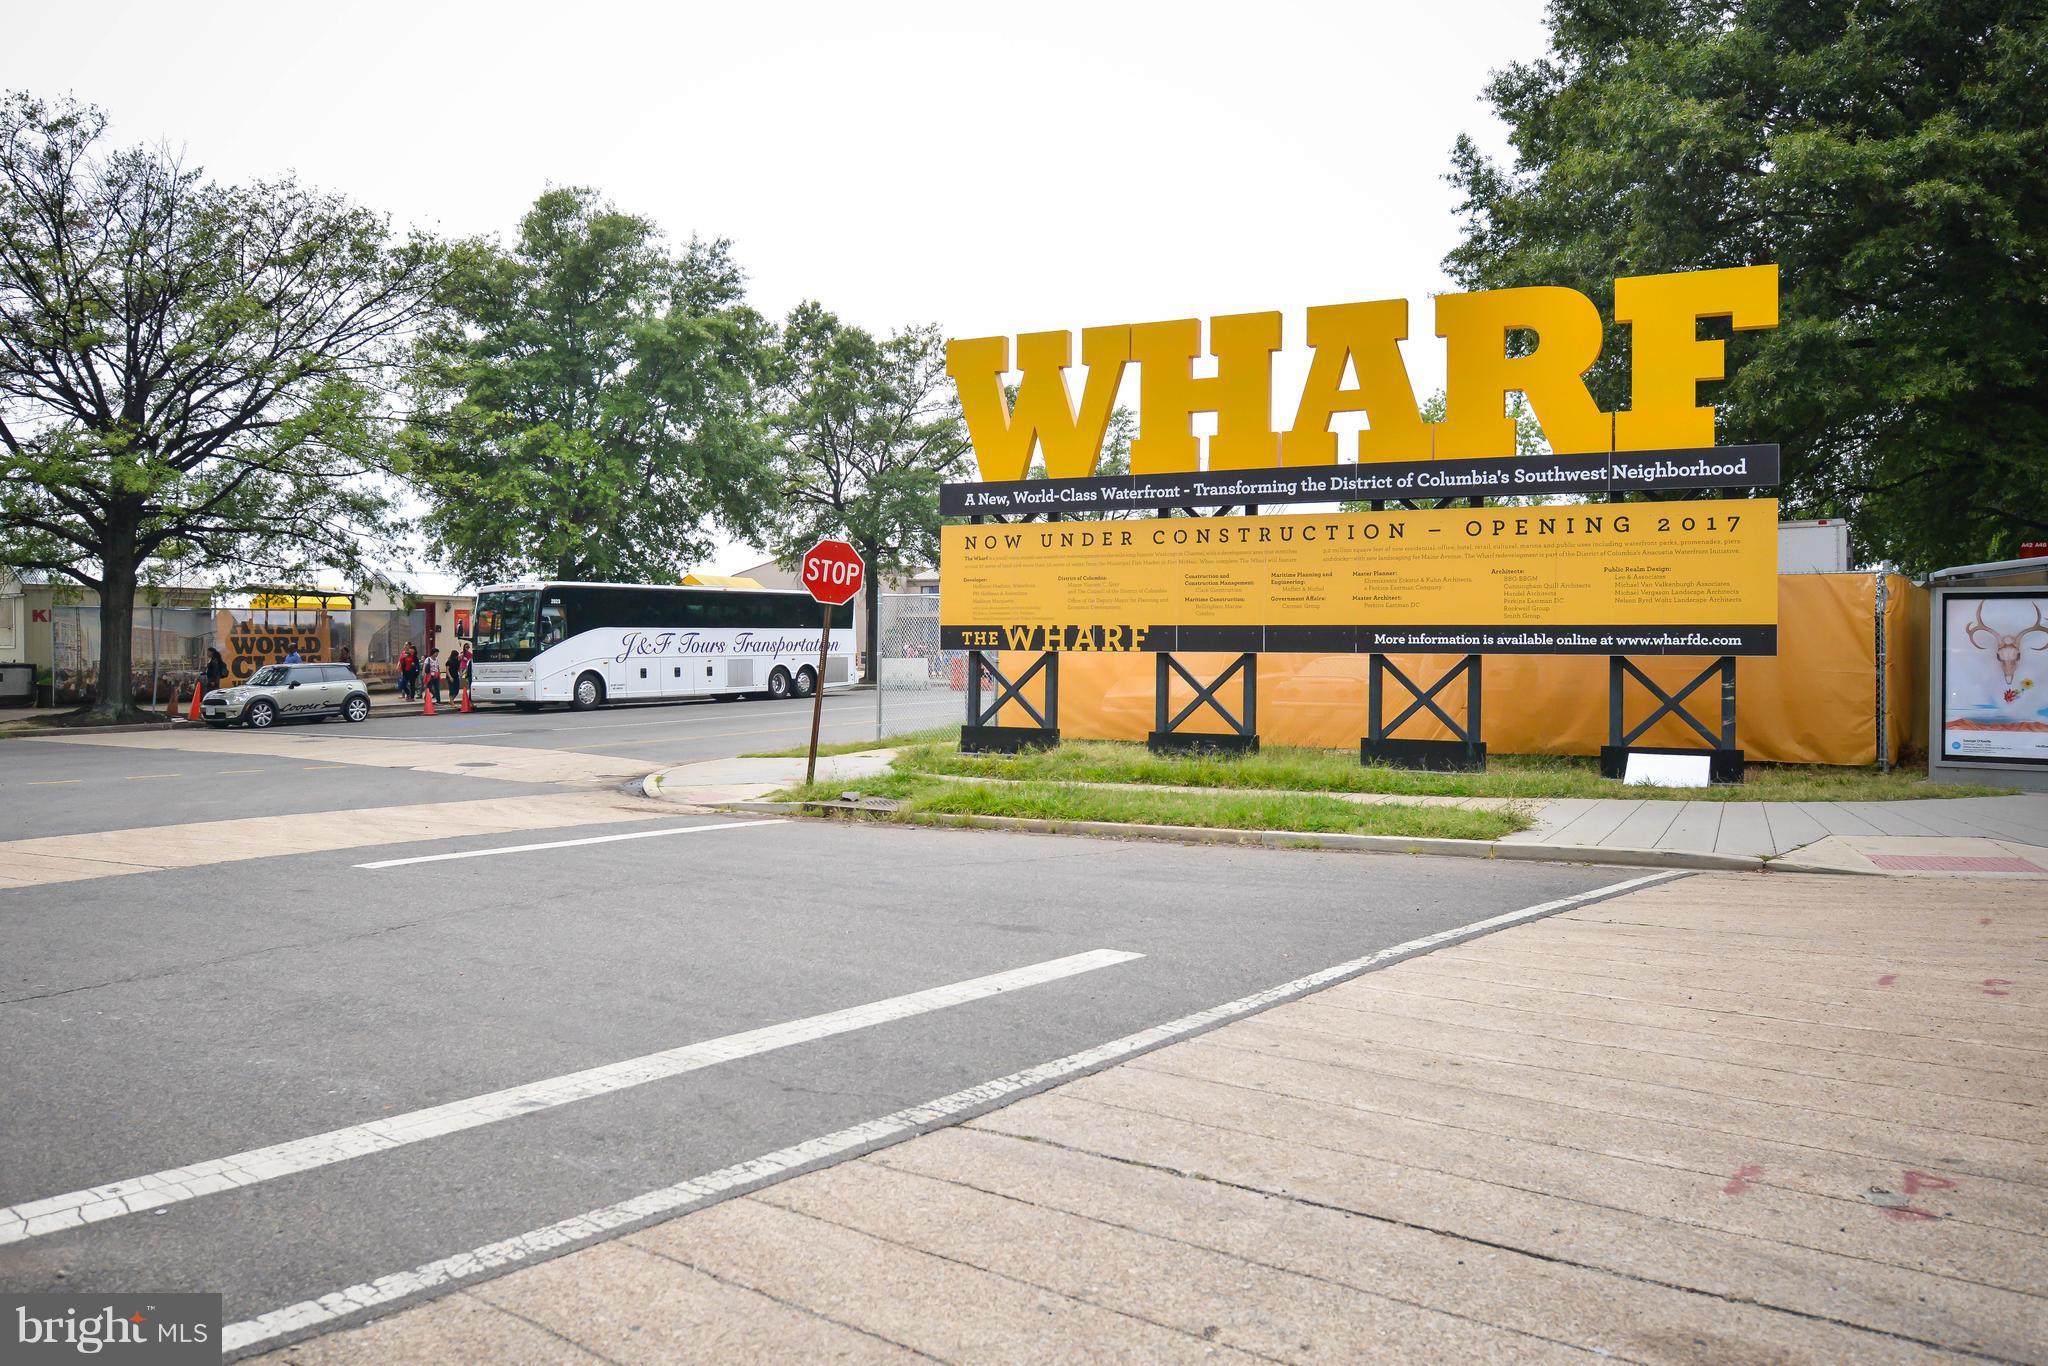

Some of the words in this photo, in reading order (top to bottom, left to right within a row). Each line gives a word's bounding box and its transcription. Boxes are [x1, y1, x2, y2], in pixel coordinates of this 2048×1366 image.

[946, 264, 1779, 482] WHARF
[965, 494, 975, 505] A
[978, 493, 1009, 506] New,
[1013, 488, 1097, 504] World-Class
[1101, 484, 1180, 500] Waterfront
[1194, 480, 1297, 496] Transforming
[1301, 477, 1326, 492] the
[1330, 475, 1392, 491] District
[1397, 473, 1414, 487] of
[1418, 469, 1509, 487] Columbia's
[1515, 465, 1607, 483] Southwest
[1612, 458, 1747, 482] Neighborhood
[965, 535, 1021, 549] NOW
[1041, 532, 1132, 547] UNDER
[1153, 523, 1404, 544] CONSTRUCTION
[1466, 517, 1630, 536] OPENING
[1658, 517, 1741, 533] 2017
[807, 558, 860, 586] STOP
[1654, 581, 1694, 589] Valkenburgh
[230, 637, 321, 654] WORLD
[616, 632, 676, 663] J&F
[678, 632, 727, 654] Tours
[733, 632, 840, 659] Transportaton
[962, 632, 998, 645] THE
[1002, 625, 1149, 651] WHARF
[1374, 634, 1405, 645] More
[1408, 633, 1480, 645] information
[1483, 634, 1493, 645] is
[1496, 633, 1553, 645] available
[1557, 633, 1597, 645] online
[1600, 635, 1613, 645] at
[1616, 633, 1742, 645] www.wharfdc.com
[280, 704, 320, 712] Cooper
